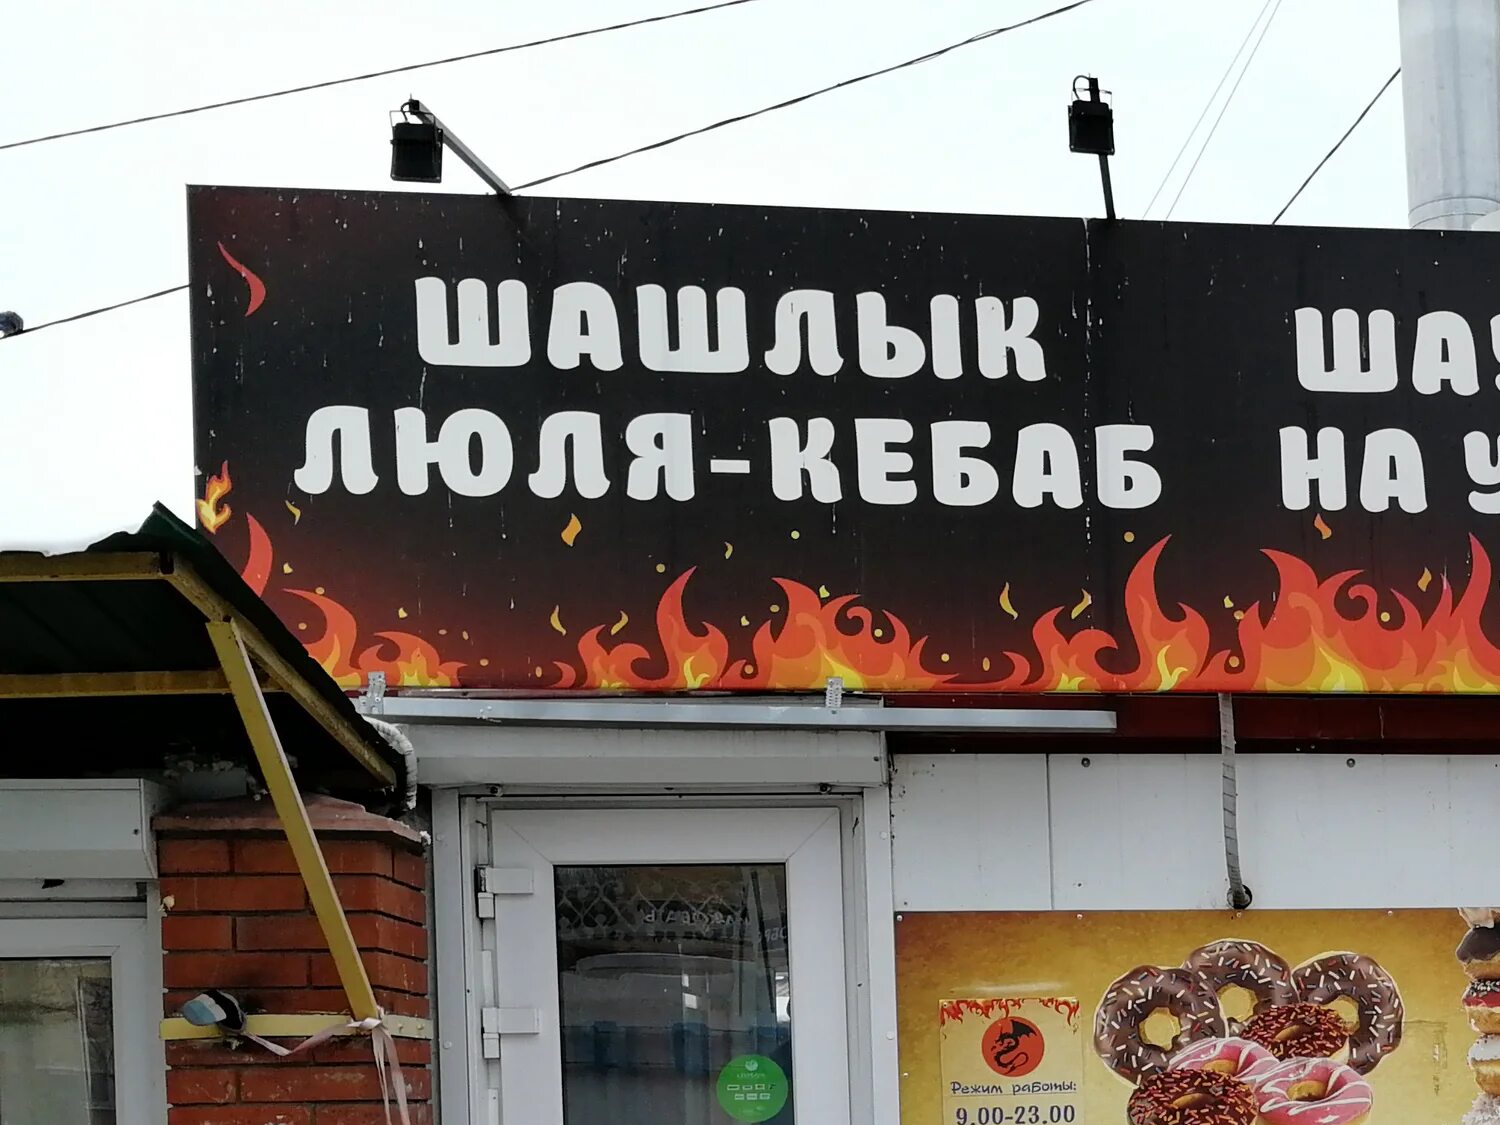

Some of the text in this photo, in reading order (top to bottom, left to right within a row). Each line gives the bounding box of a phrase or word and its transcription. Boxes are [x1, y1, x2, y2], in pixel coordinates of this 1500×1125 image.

[414, 276, 1047, 382] ШАШЛЫК
[293, 405, 1162, 510] ЛЮЛЯ-КЕБАБ
[1278, 425, 1428, 514] НА
[951, 1080, 1078, 1096] Режим работы:
